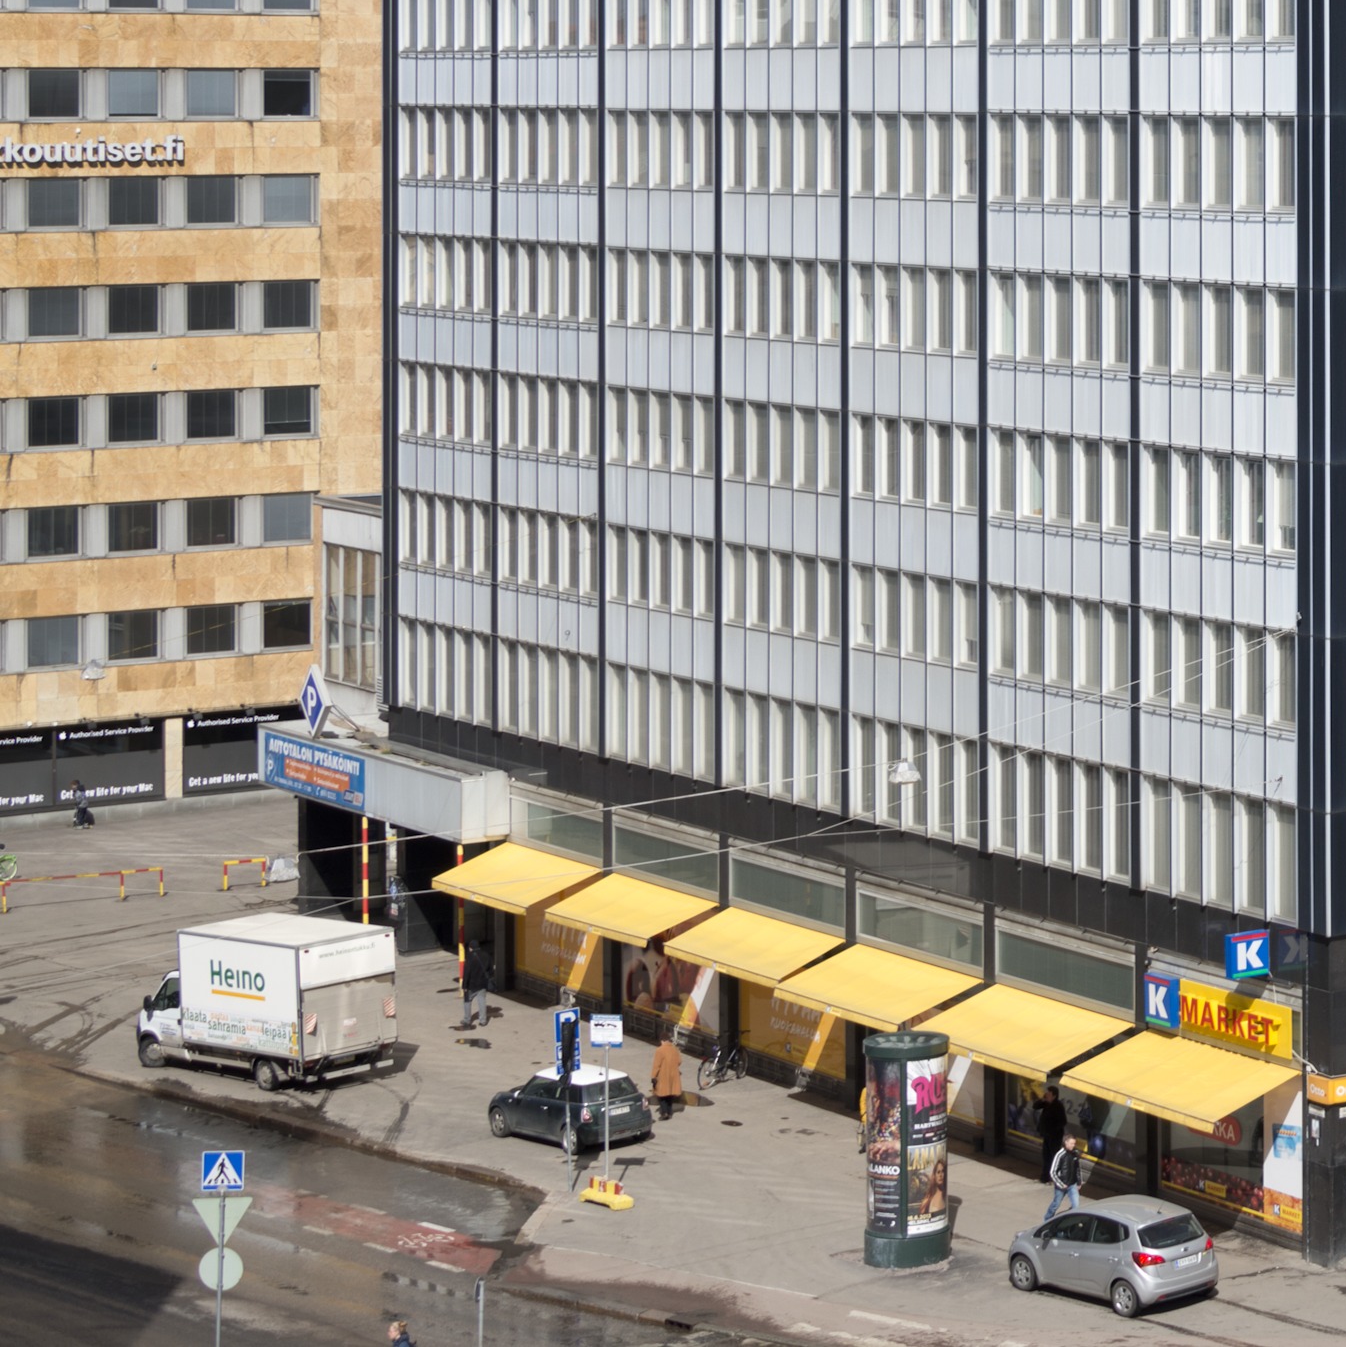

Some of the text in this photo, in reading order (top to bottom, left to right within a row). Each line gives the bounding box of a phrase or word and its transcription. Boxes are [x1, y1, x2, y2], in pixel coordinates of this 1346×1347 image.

[0, 135, 184, 164] kouutiset.fi
[307, 685, 317, 717] P
[70, 724, 154, 739] Authorised Service Provider
[197, 713, 279, 727] Authorised Service Provider
[16, 734, 43, 745] Provider
[269, 738, 312, 763] AUTOTALON
[314, 750, 360, 776] PYSÄKÖINTI
[61, 790, 74, 800] Get
[97, 786, 109, 797] life
[110, 785, 121, 796] for
[139, 783, 153, 792] Mac
[189, 777, 201, 787] Get
[209, 776, 222, 785] new
[223, 774, 235, 784] life
[236, 773, 246, 783] for
[29, 793, 44, 803] Mac
[1237, 940, 1264, 971] K
[210, 959, 265, 992] Heino
[1148, 983, 1274, 1046] K MARKET
